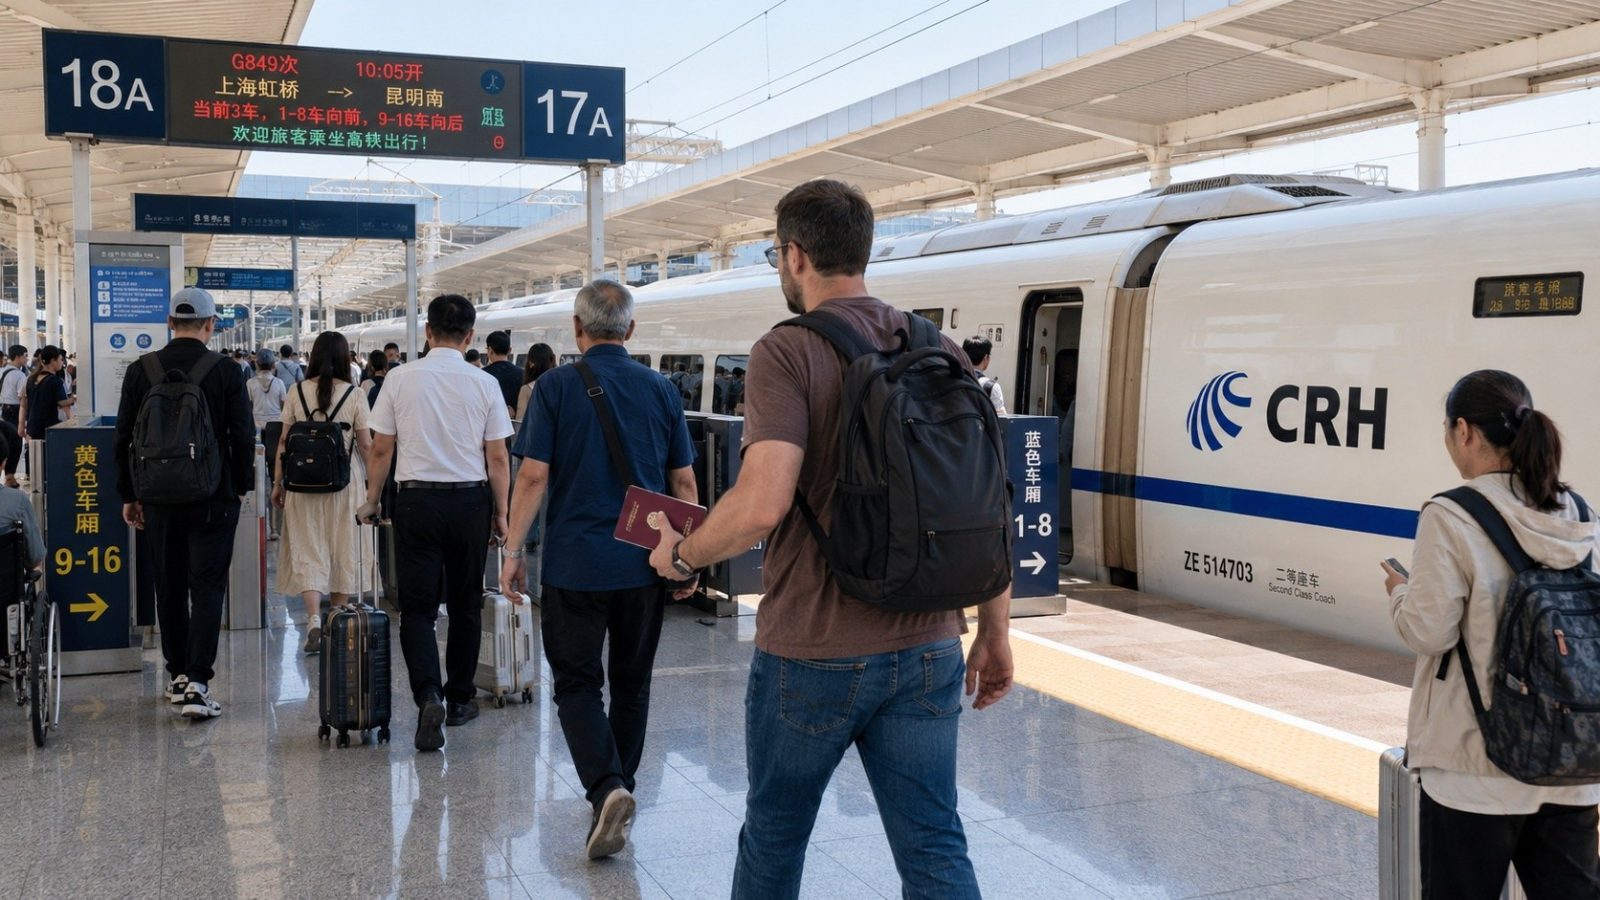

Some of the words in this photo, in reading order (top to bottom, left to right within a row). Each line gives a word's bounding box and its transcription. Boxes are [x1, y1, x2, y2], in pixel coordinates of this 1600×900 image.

[232, 53, 298, 74] G849次
[356, 62, 423, 82] 10:05开
[61, 58, 153, 112] 18A
[215, 75, 299, 99] 上海虹桥
[386, 86, 444, 108] 昆明南
[537, 88, 613, 137] 17A
[1265, 384, 1388, 450] CRH
[1024, 430, 1041, 504] 蓝色车厢
[74, 445, 100, 534] 黄色车厢
[1014, 512, 1053, 538] 1-8
[55, 545, 121, 575] 9-16
[1184, 550, 1200, 573] ZE
[1203, 554, 1254, 583] 514703
[1268, 582, 1293, 596] Second
[1294, 588, 1313, 601] Class
[1314, 592, 1337, 605] Coach
[1276, 568, 1320, 588] 二等座车
